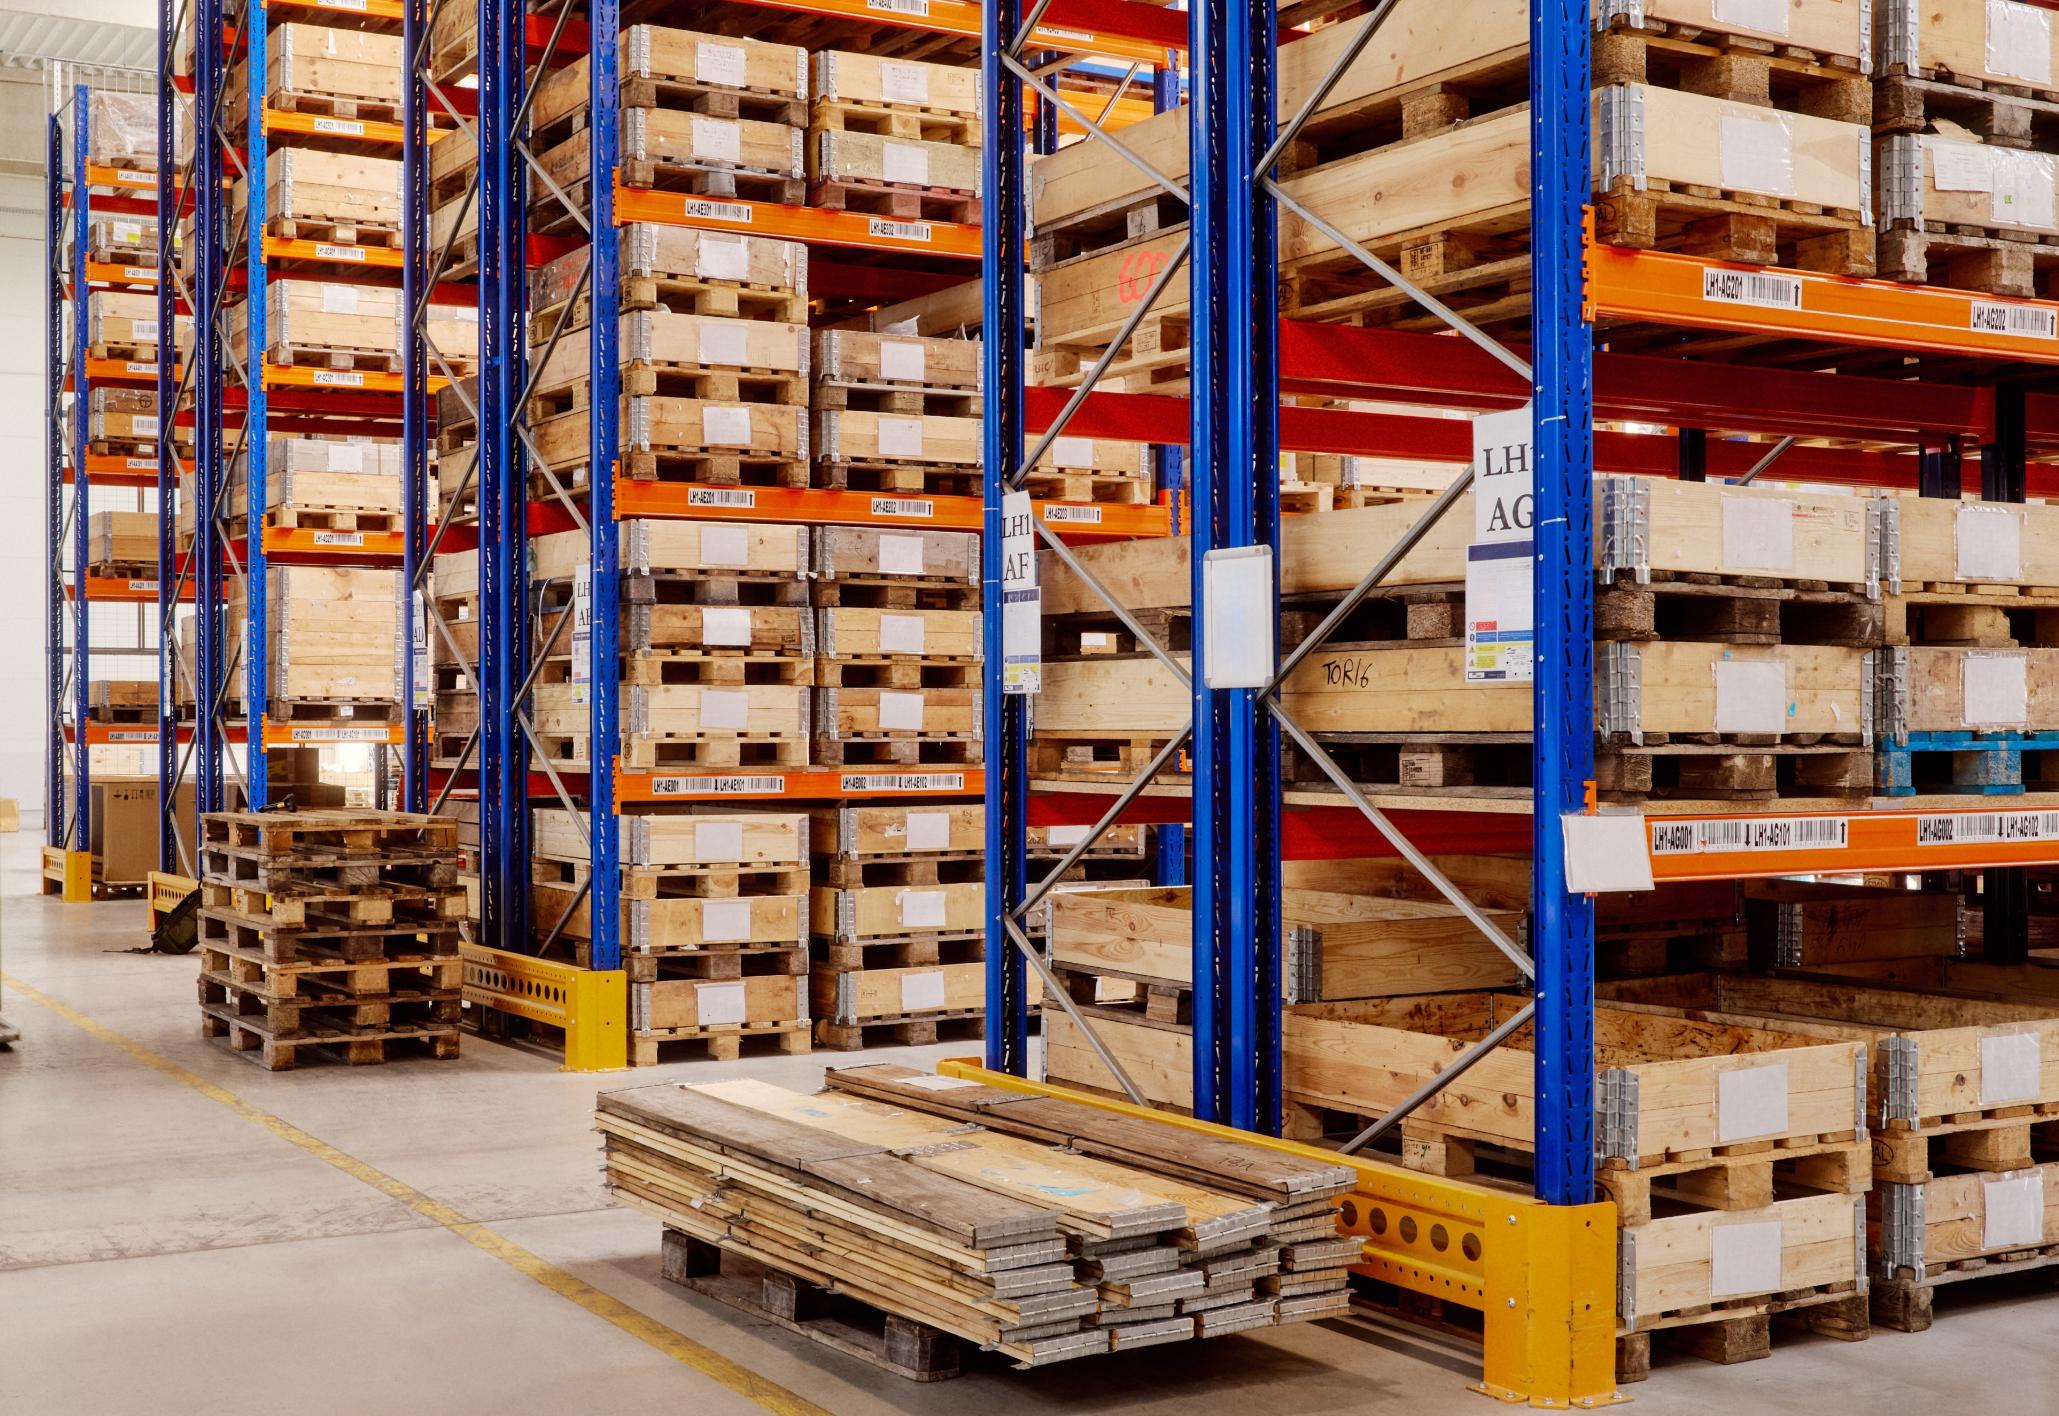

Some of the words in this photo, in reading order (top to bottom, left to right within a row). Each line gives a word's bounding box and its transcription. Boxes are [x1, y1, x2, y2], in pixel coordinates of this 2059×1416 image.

[1705, 272, 1742, 300] LH1-AG201
[1973, 305, 2006, 331] LH1-AG202
[1483, 443, 1533, 477] LH
[1002, 513, 1031, 539] LH1
[1486, 493, 1533, 533] AG
[1003, 552, 1029, 581] AF
[577, 581, 591, 598] LH
[1654, 825, 1692, 851] LH1-AG001
[1754, 822, 1791, 847] LH1-AG101
[1919, 818, 1953, 842] LH1-AG002
[2006, 815, 2039, 838] LH1-AG102
